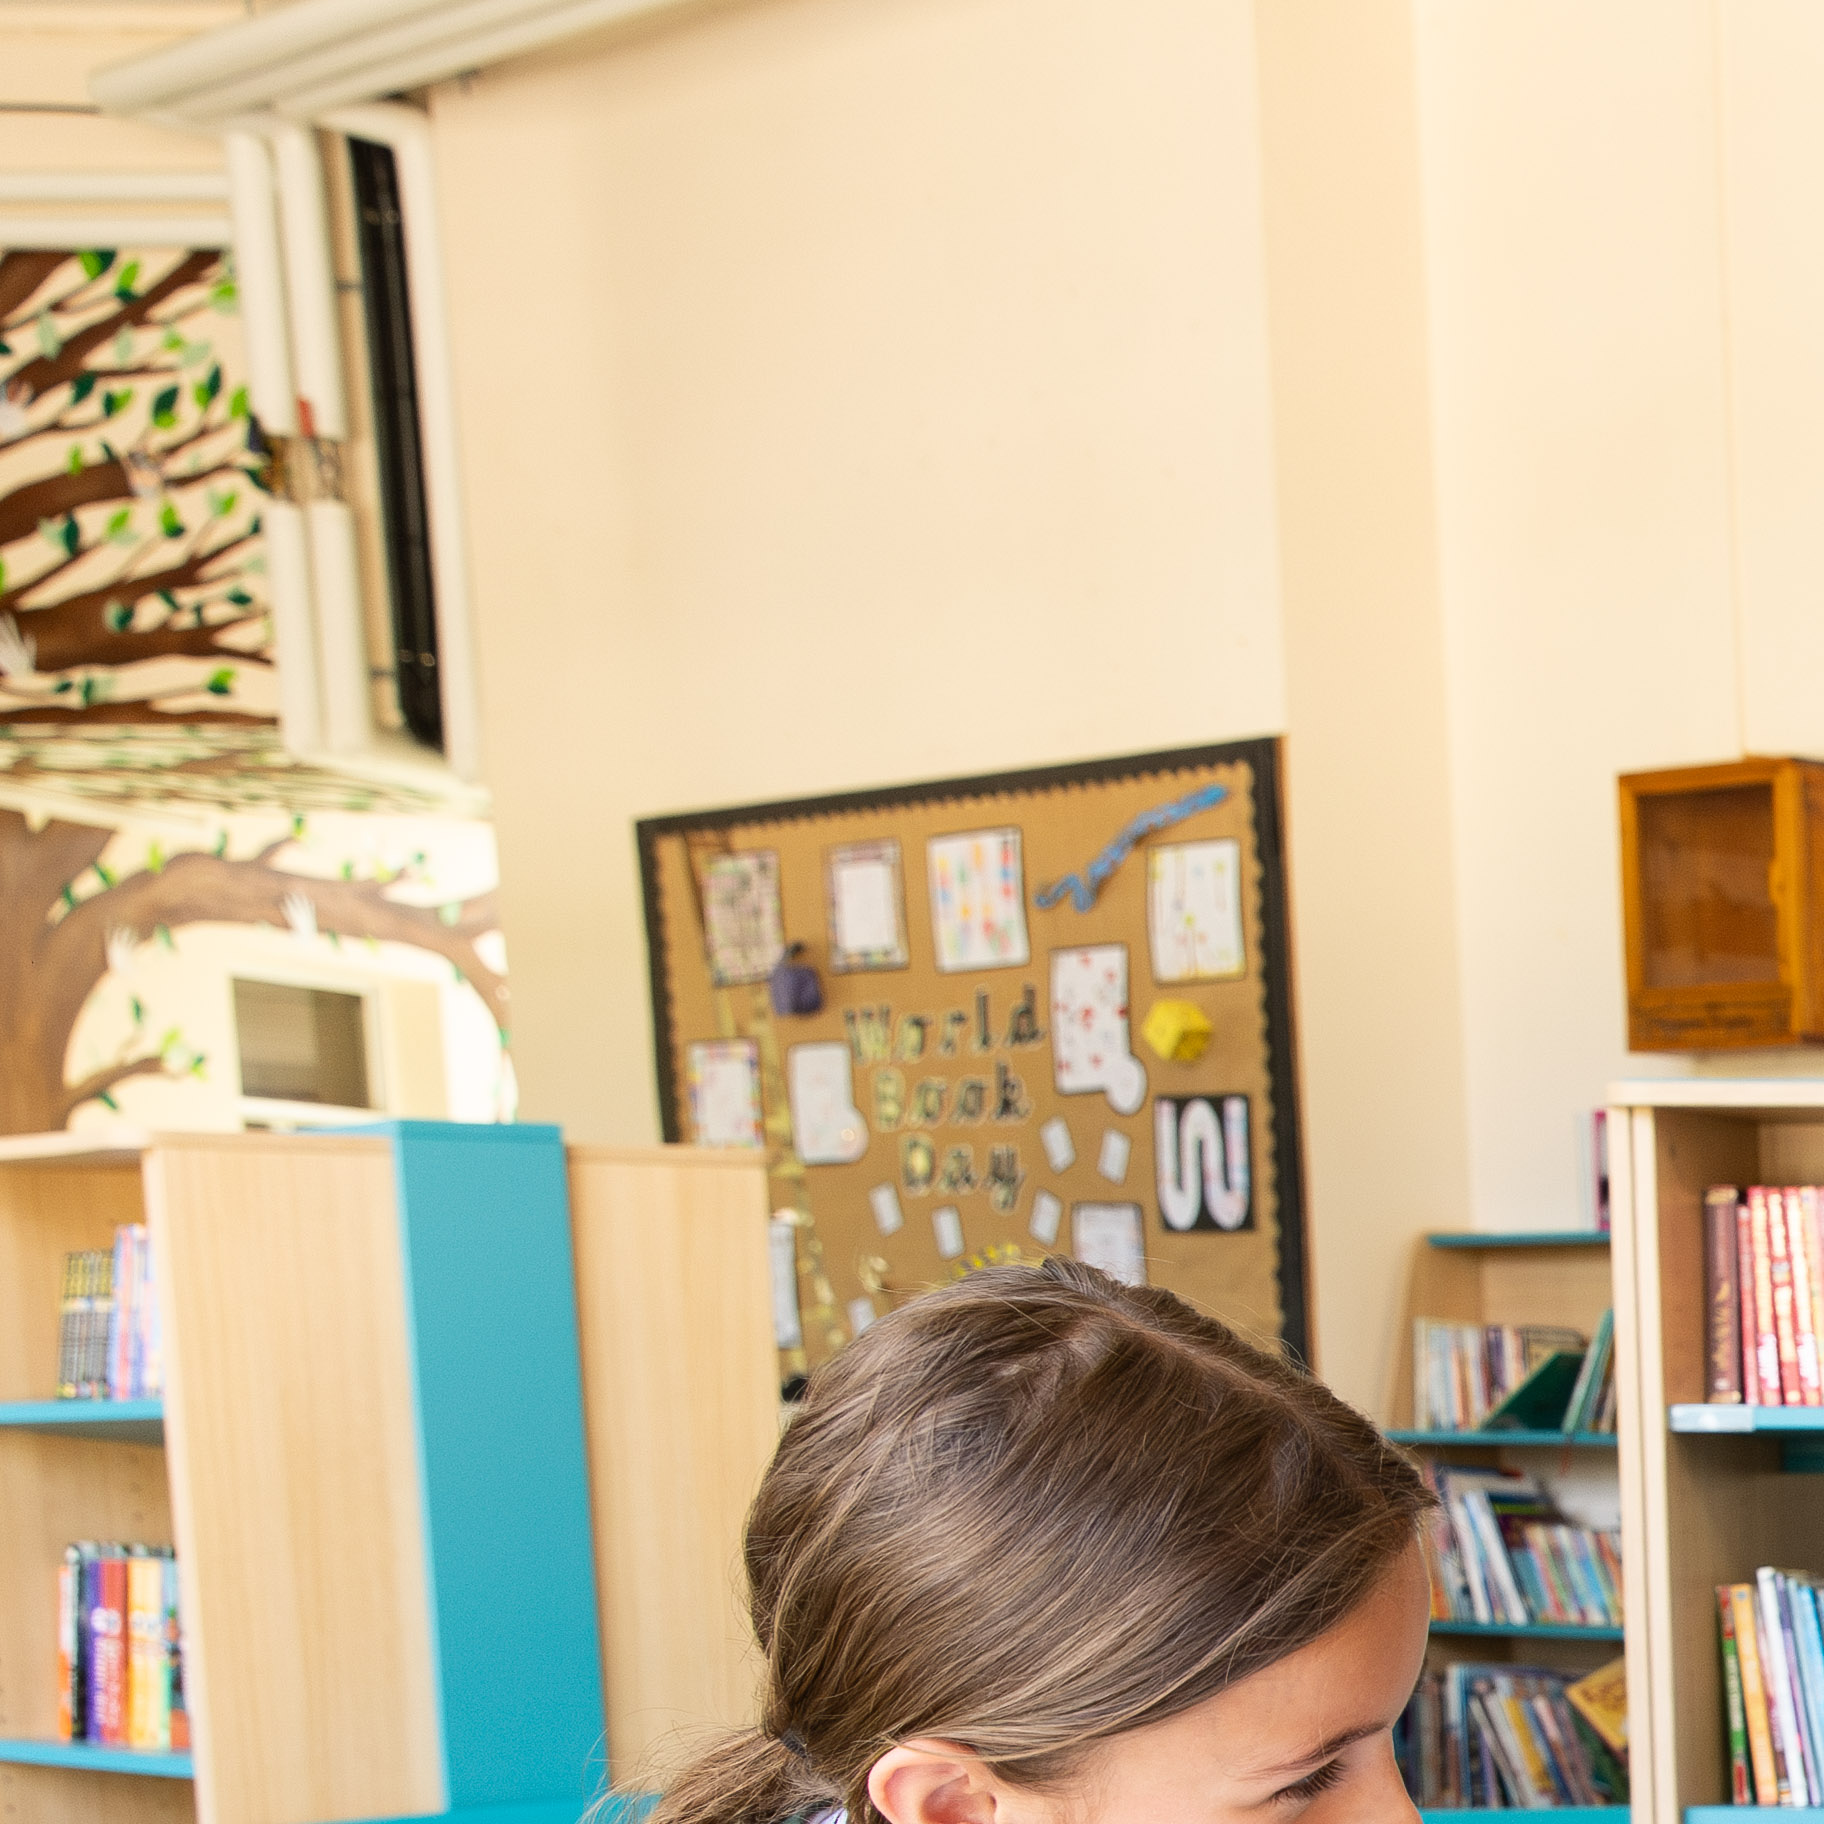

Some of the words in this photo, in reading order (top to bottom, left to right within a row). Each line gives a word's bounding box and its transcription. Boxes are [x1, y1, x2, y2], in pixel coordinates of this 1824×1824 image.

[844, 981, 1048, 1067] World
[871, 1056, 1036, 1133] Book
[898, 1132, 1026, 1215] Day
